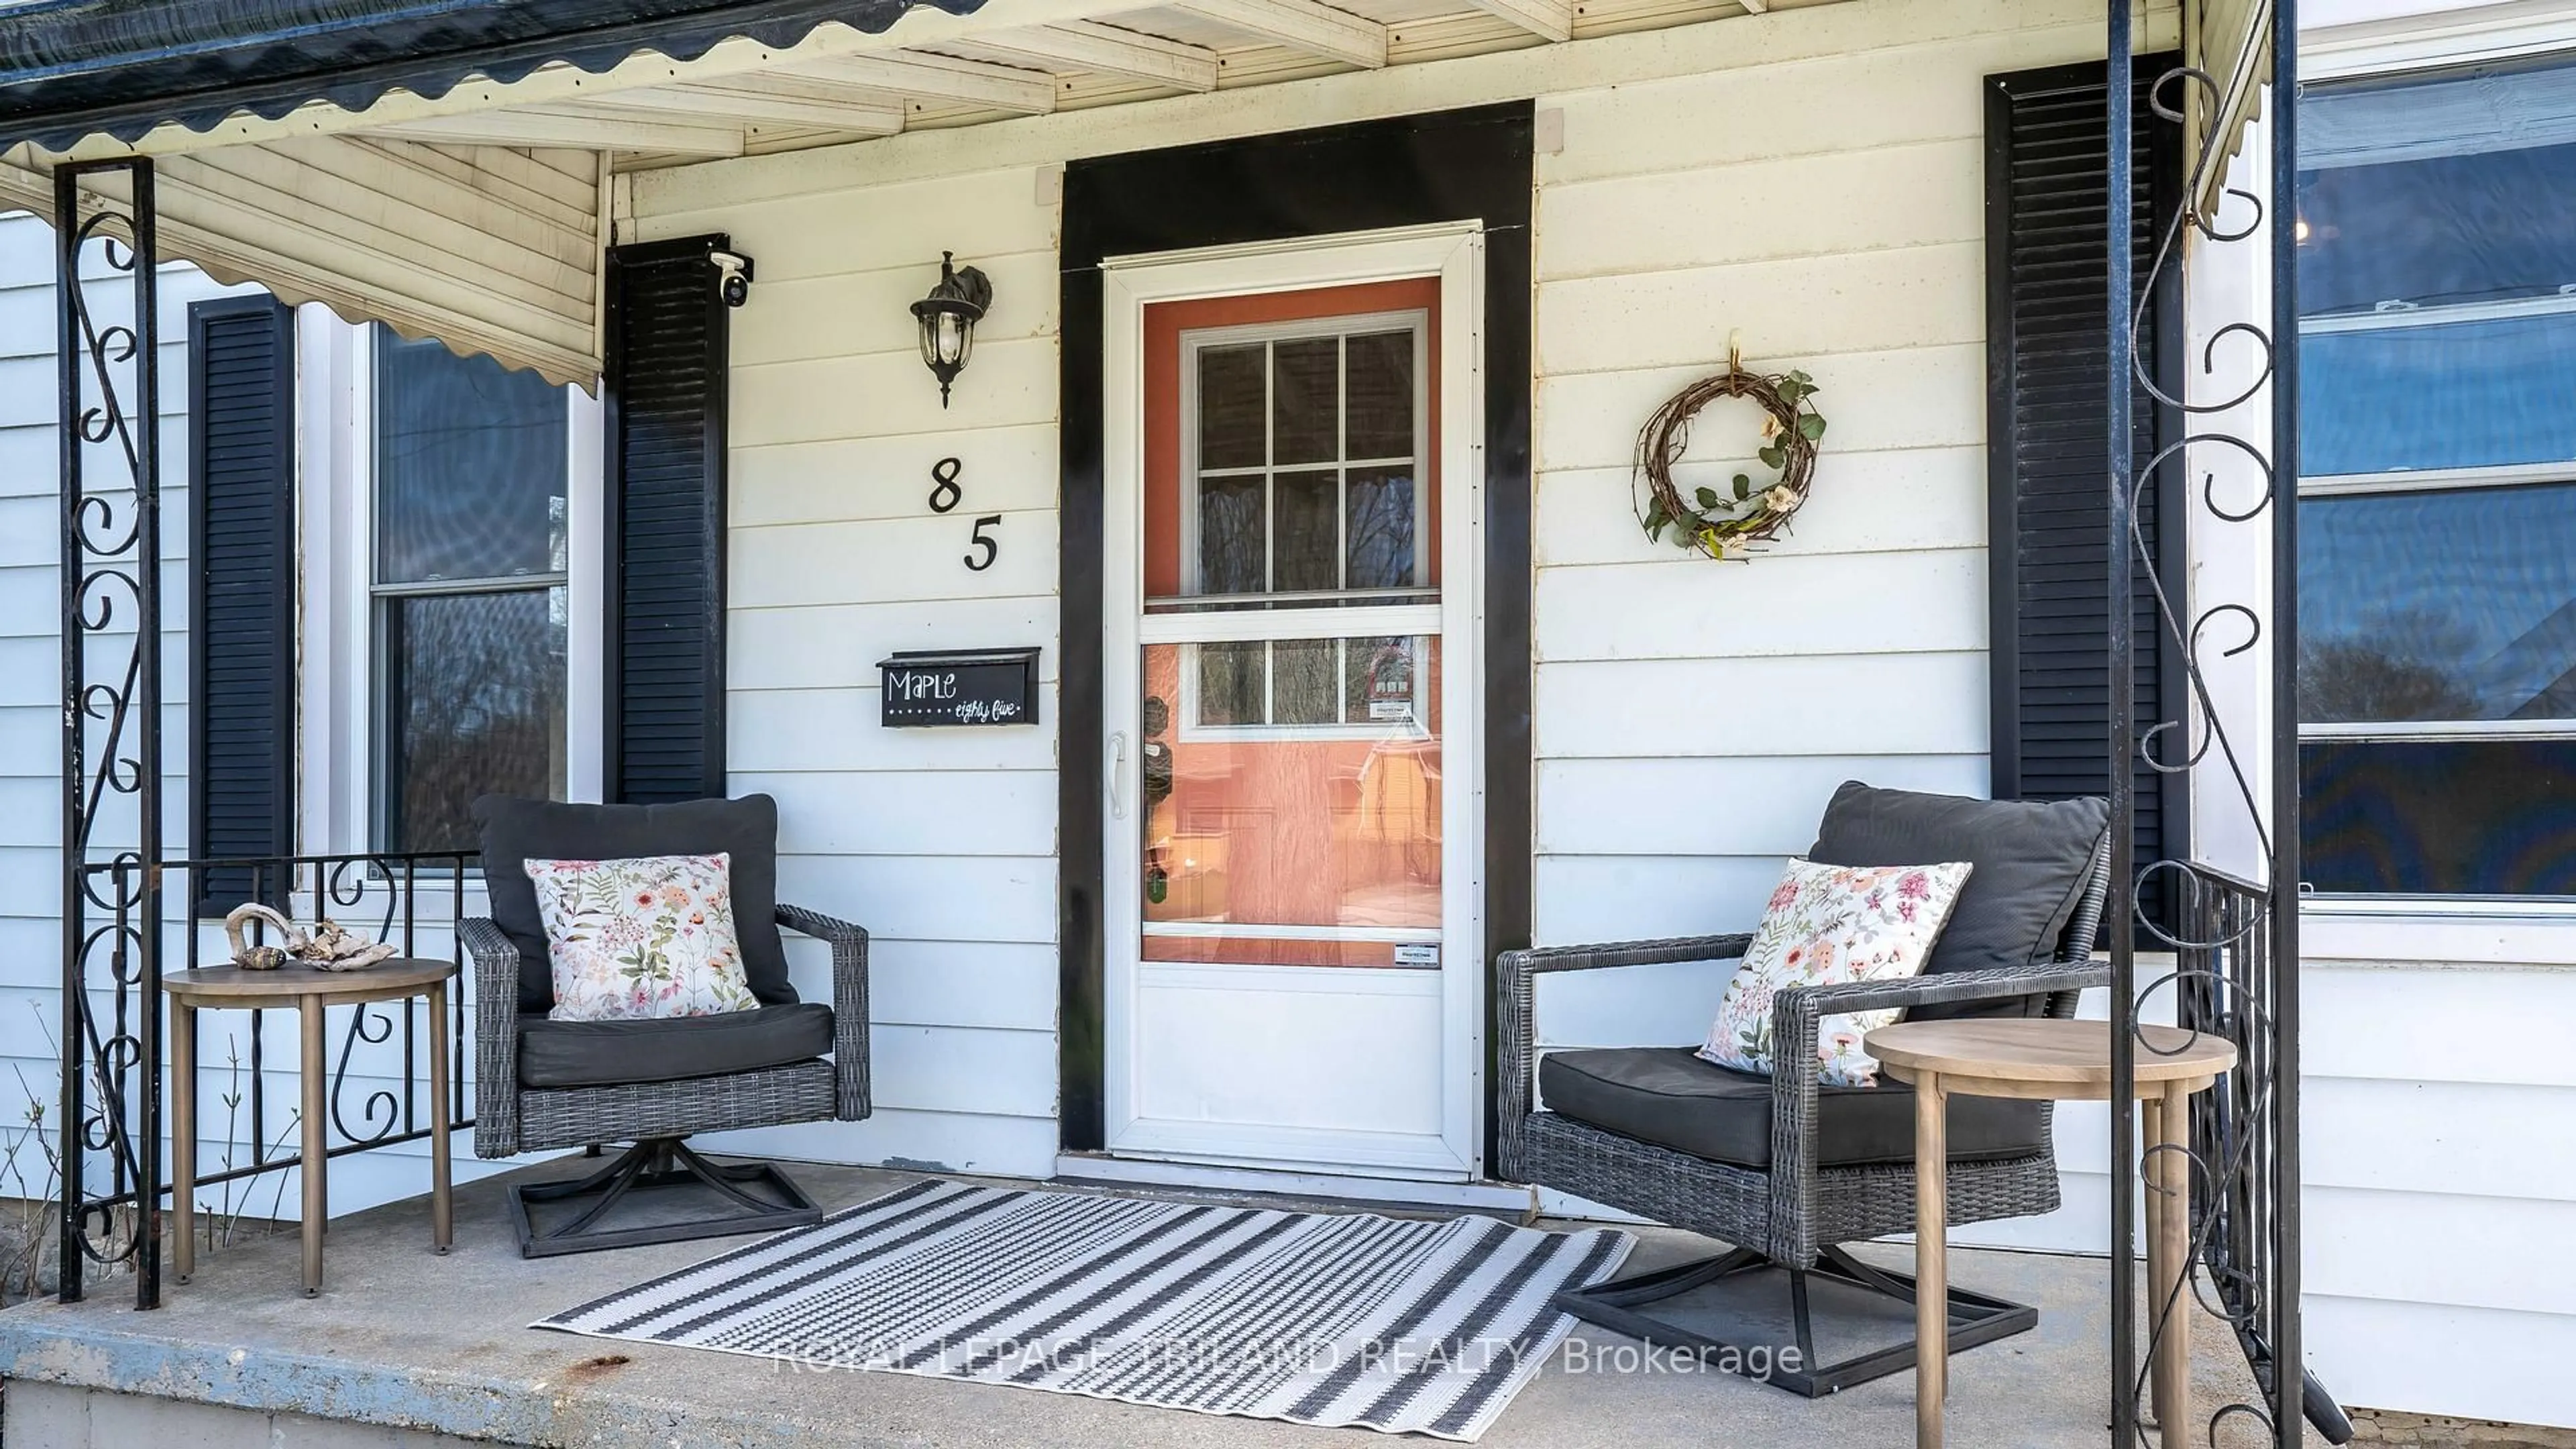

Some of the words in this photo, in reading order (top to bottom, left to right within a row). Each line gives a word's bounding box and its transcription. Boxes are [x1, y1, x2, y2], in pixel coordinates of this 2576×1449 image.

[929, 458, 961, 513] 8
[964, 515, 1002, 571] 5
[955, 700, 989, 723] eighty
